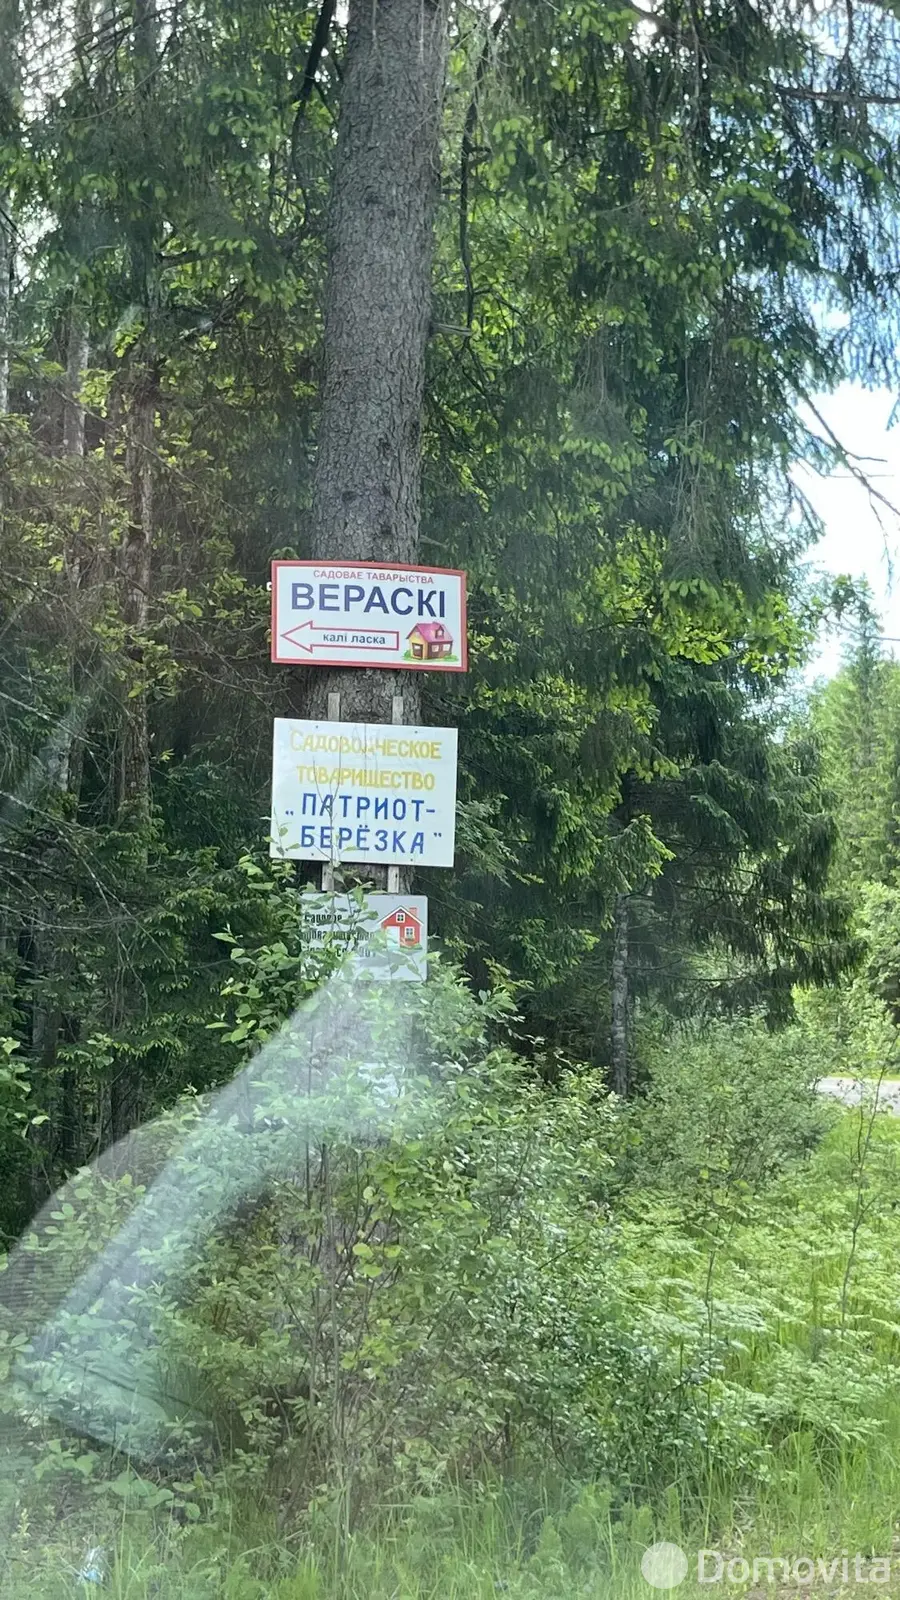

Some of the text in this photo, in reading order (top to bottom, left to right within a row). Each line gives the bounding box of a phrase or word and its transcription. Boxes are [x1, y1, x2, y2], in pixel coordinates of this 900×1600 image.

[313, 569, 434, 585] САДОВАЕ ТАВАРЫСТВА
[291, 582, 446, 618] ВЕРАСКІ
[323, 632, 386, 645] калі ласка
[296, 765, 436, 791] ТОВАРИЩЕСТВО
